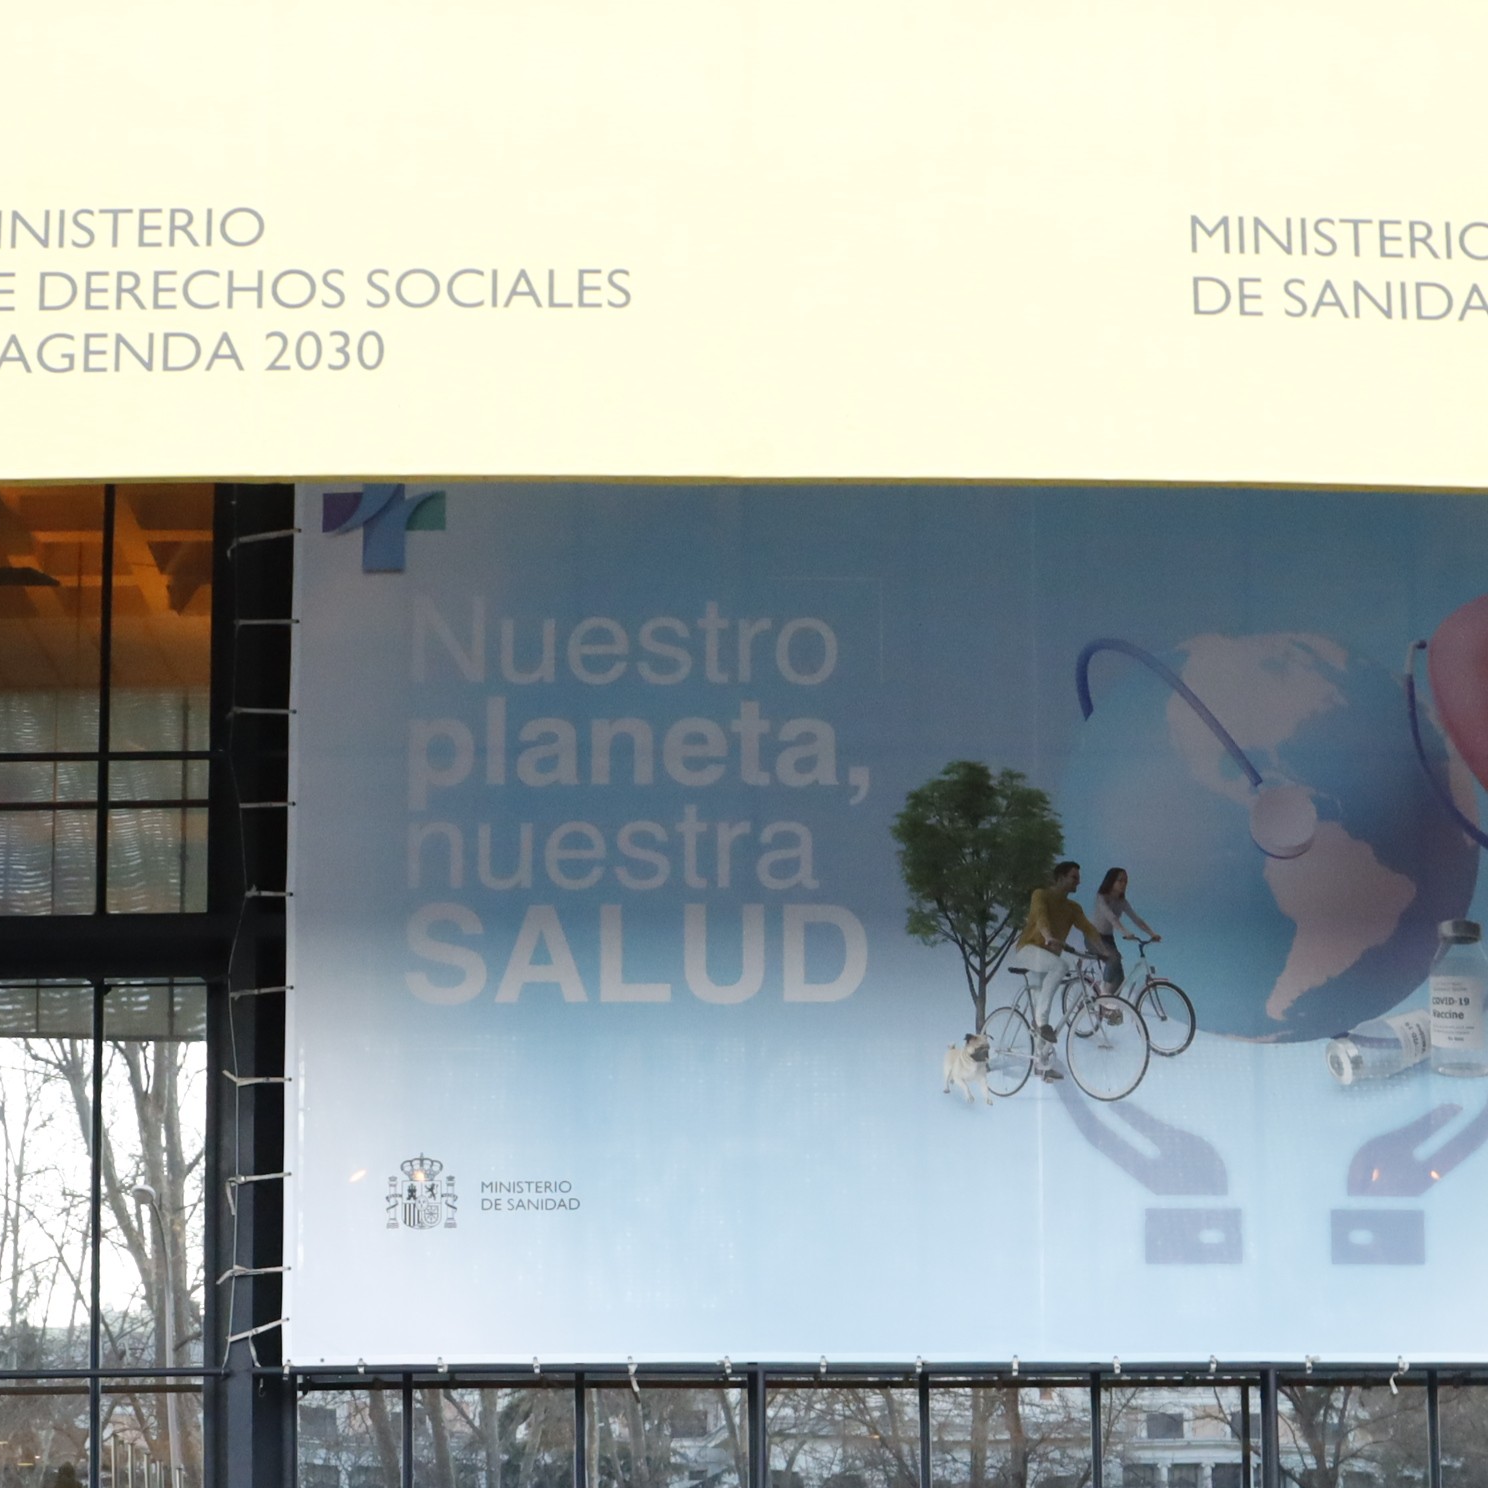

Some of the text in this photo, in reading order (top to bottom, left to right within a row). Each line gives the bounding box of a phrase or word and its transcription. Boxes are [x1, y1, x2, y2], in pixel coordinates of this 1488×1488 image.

[38, 269, 346, 311] DERECHOS
[366, 268, 633, 309] SOCIALES
[1192, 276, 1264, 316] DE
[264, 329, 385, 373] 2030
[414, 599, 838, 686] Nuestro
[408, 696, 870, 811] planeta,
[406, 804, 819, 890] nuestra
[404, 902, 869, 1004] SALUD
[481, 1180, 572, 1194] MINISTERIO
[481, 1197, 581, 1211] DE SANIDAD
